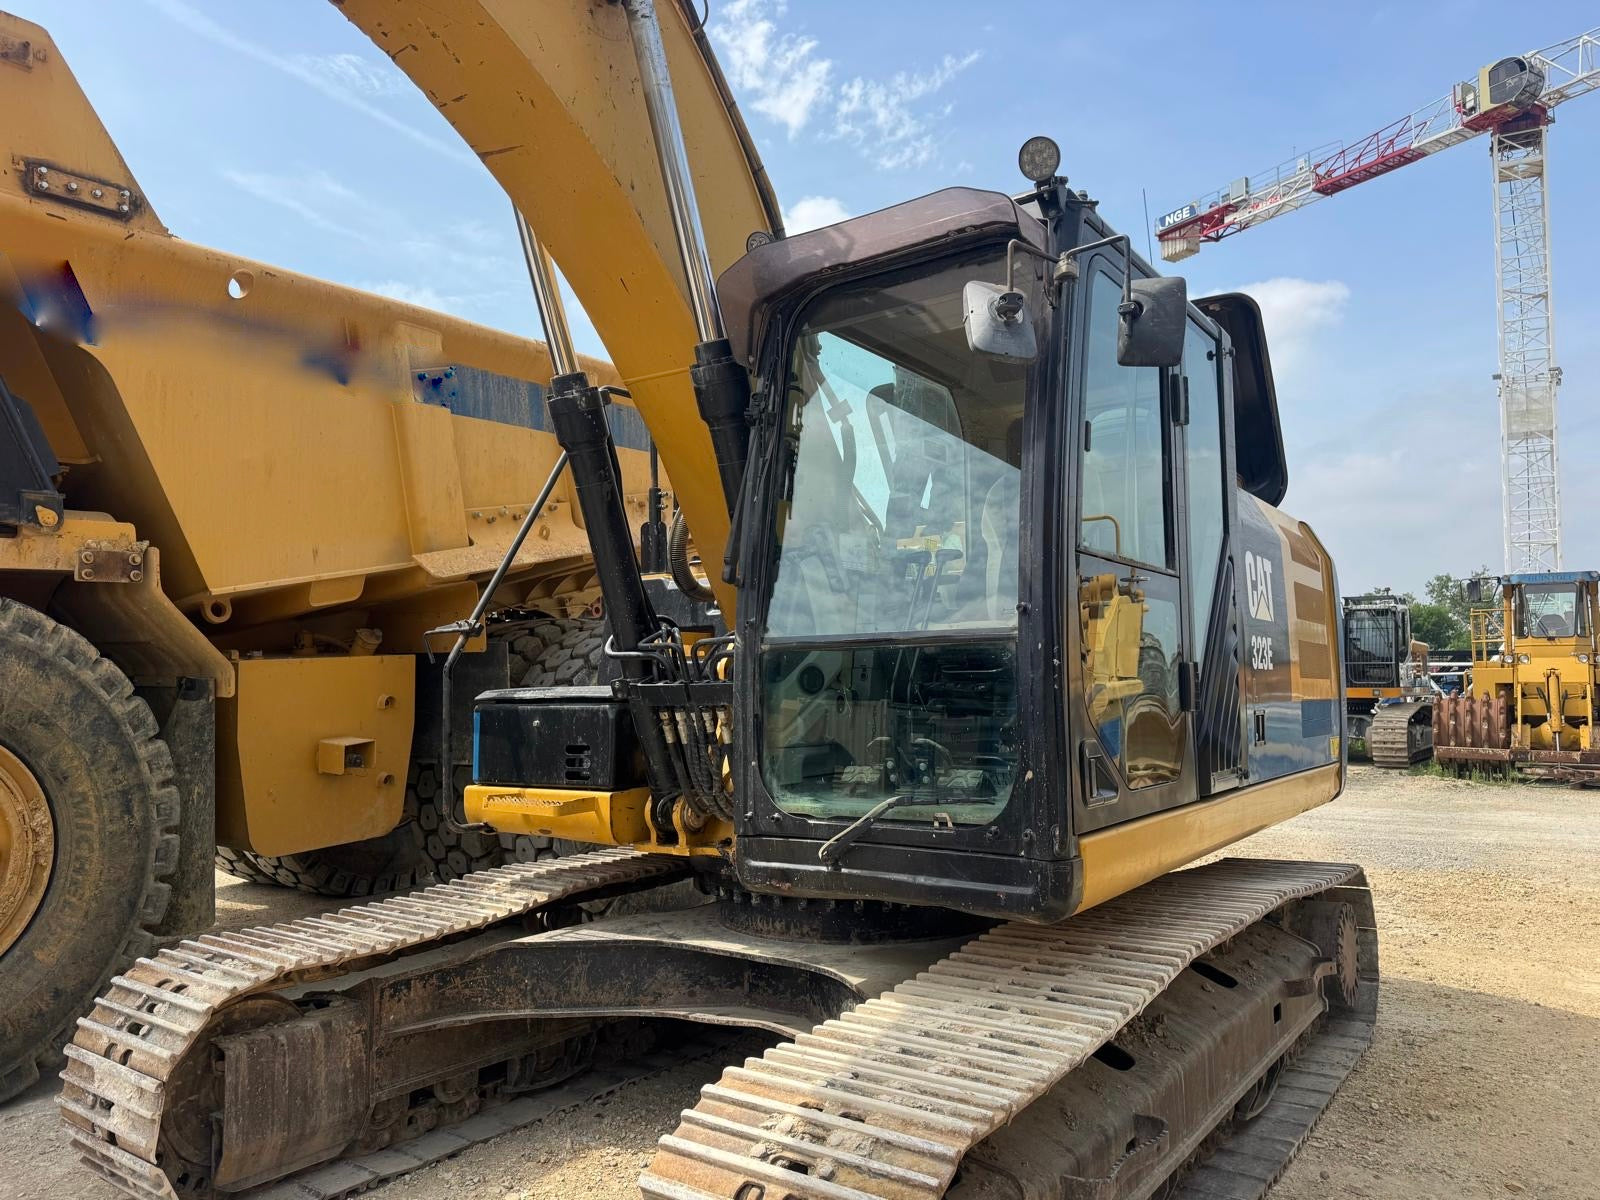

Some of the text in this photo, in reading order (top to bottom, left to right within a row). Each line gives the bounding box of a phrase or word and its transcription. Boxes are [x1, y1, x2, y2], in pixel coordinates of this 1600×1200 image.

[1165, 206, 1190, 227] NGE
[1245, 551, 1274, 622] CAT
[1251, 635, 1274, 671] 323E
